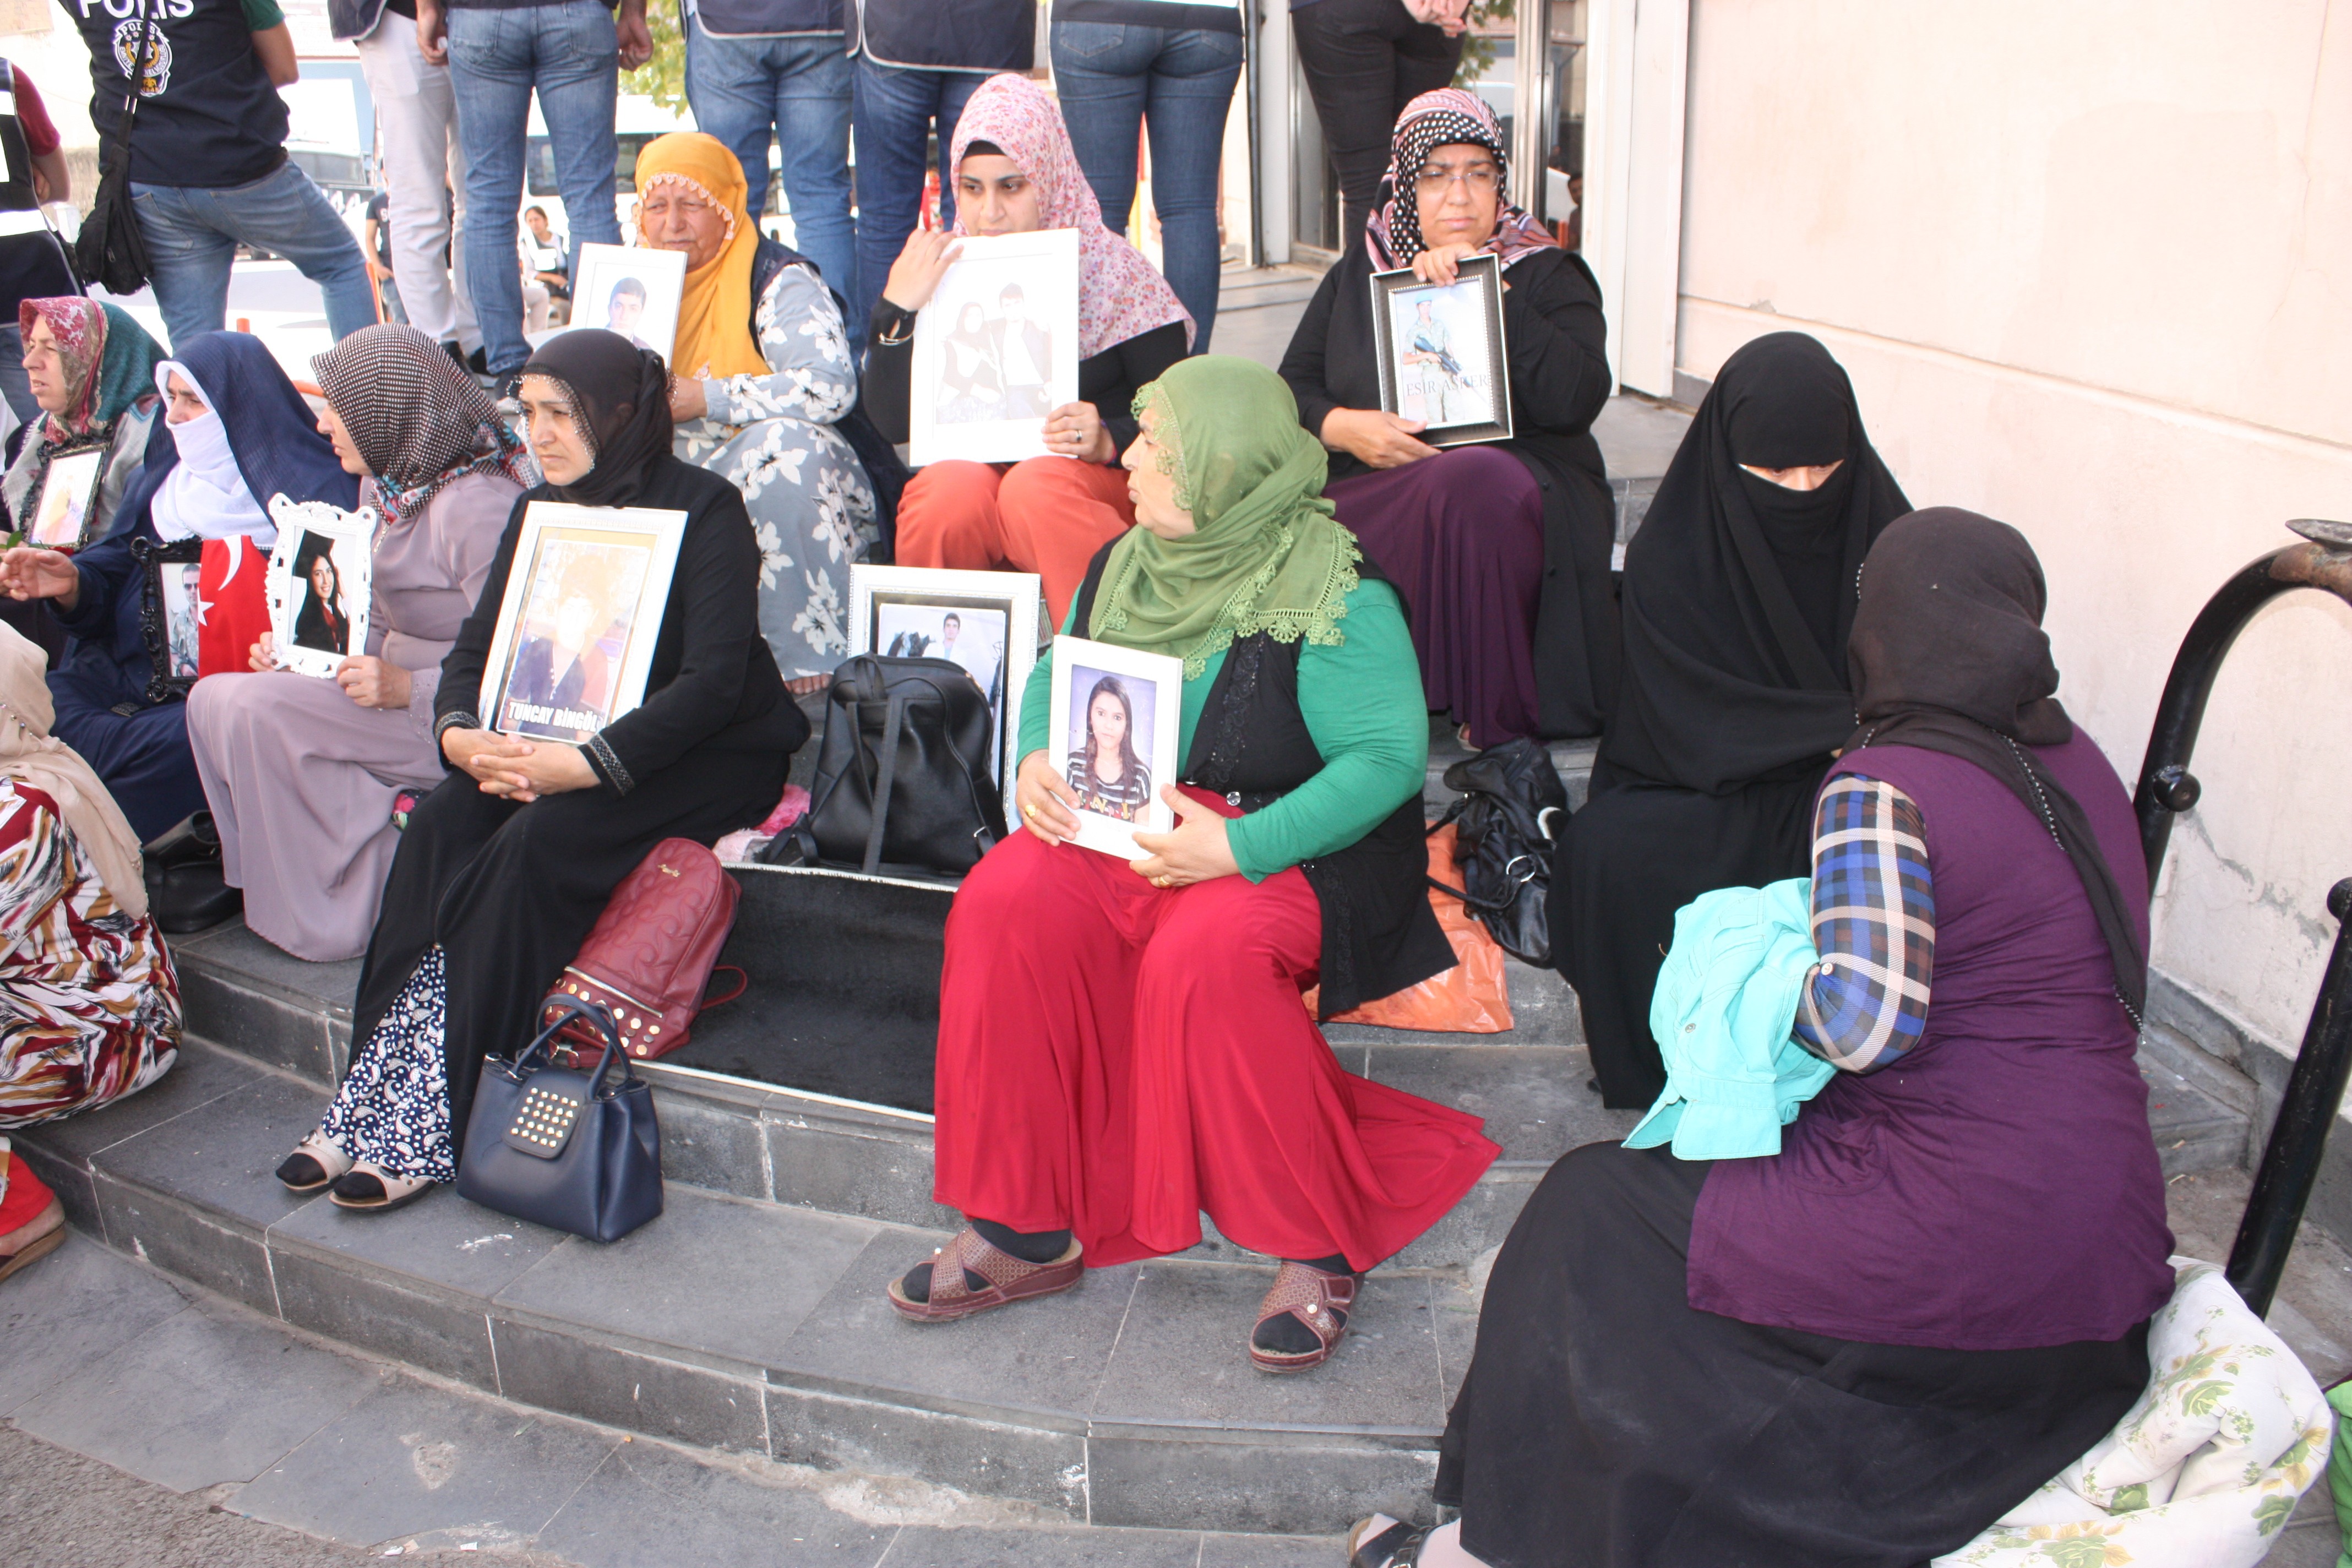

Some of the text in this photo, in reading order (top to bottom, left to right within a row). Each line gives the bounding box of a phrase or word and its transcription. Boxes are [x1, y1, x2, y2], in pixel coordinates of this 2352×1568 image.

[121, 22, 156, 36] POLS
[1443, 374, 1489, 390] ASKER
[508, 701, 598, 733] TUNCAY BİNGÖL
